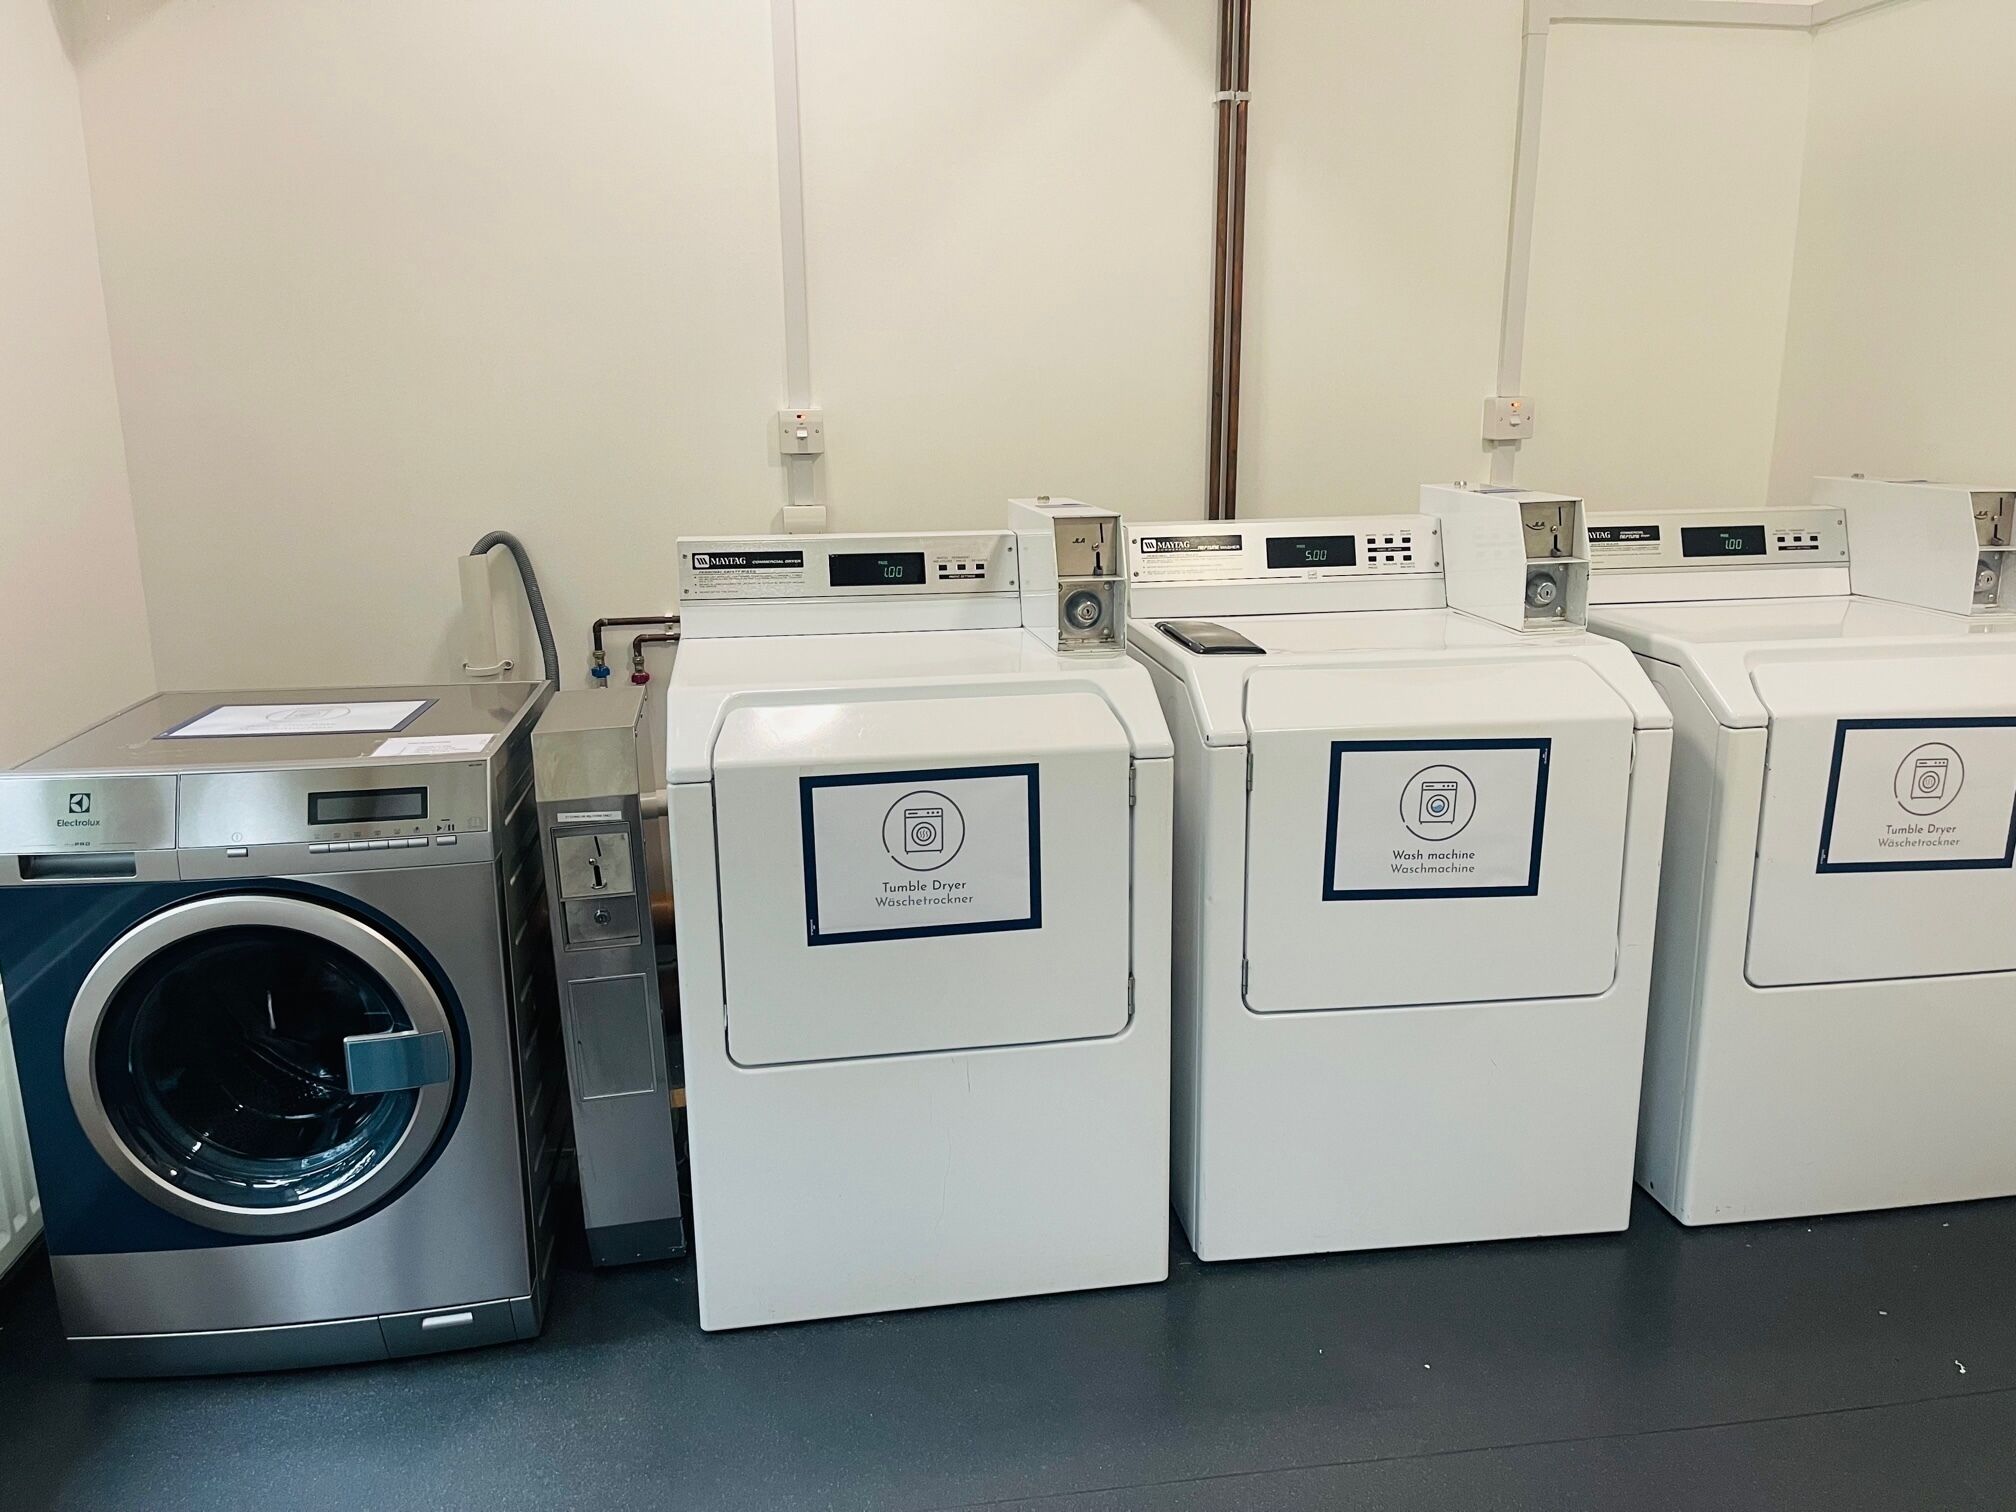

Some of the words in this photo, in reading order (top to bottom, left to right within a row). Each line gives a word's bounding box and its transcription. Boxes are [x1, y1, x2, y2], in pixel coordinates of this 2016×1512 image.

[1588, 531, 1611, 539] AYTAG
[1157, 541, 1190, 549] MAYTAG
[710, 557, 746, 565] MAYTAG
[1305, 550, 1327, 561] 5.00
[57, 818, 100, 828] Electrolux
[1886, 824, 1923, 834] Tumble
[1927, 824, 1957, 835] Dryer
[1878, 836, 1960, 847] Wäschetrockner
[1393, 849, 1423, 861] Wash
[1427, 849, 1475, 861] machine
[1391, 863, 1475, 873] Waschmachine
[882, 879, 928, 892] Tumble
[932, 879, 967, 892] Dryer
[875, 893, 974, 906] Wäschetrockner
